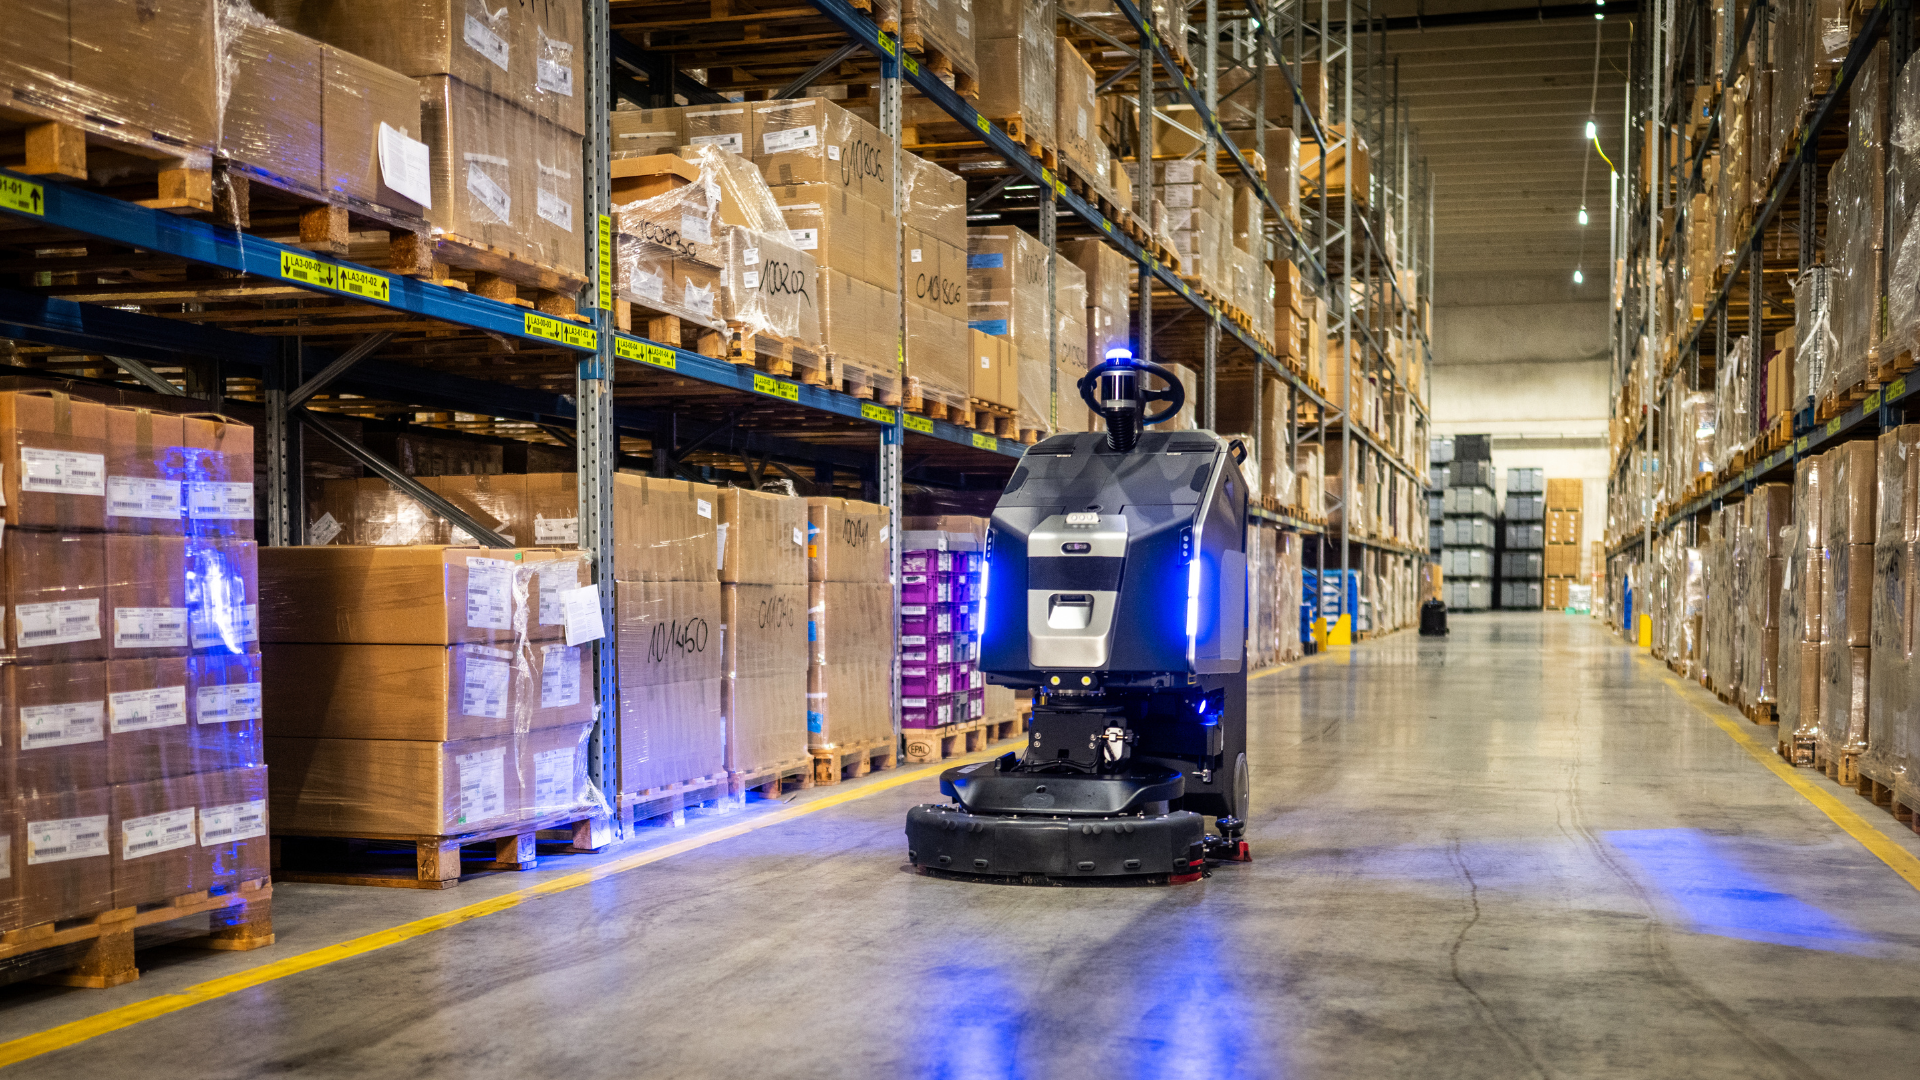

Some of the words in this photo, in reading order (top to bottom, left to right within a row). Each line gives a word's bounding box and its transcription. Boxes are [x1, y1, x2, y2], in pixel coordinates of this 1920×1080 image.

[841, 139, 884, 186] 010806
[290, 256, 322, 273] LA3-00-02
[347, 271, 378, 287] LA3-01-02
[915, 273, 962, 305] 010806
[530, 316, 552, 329] LA3-00-03
[647, 617, 709, 664] 101450
[910, 746, 927, 754] EPAL
